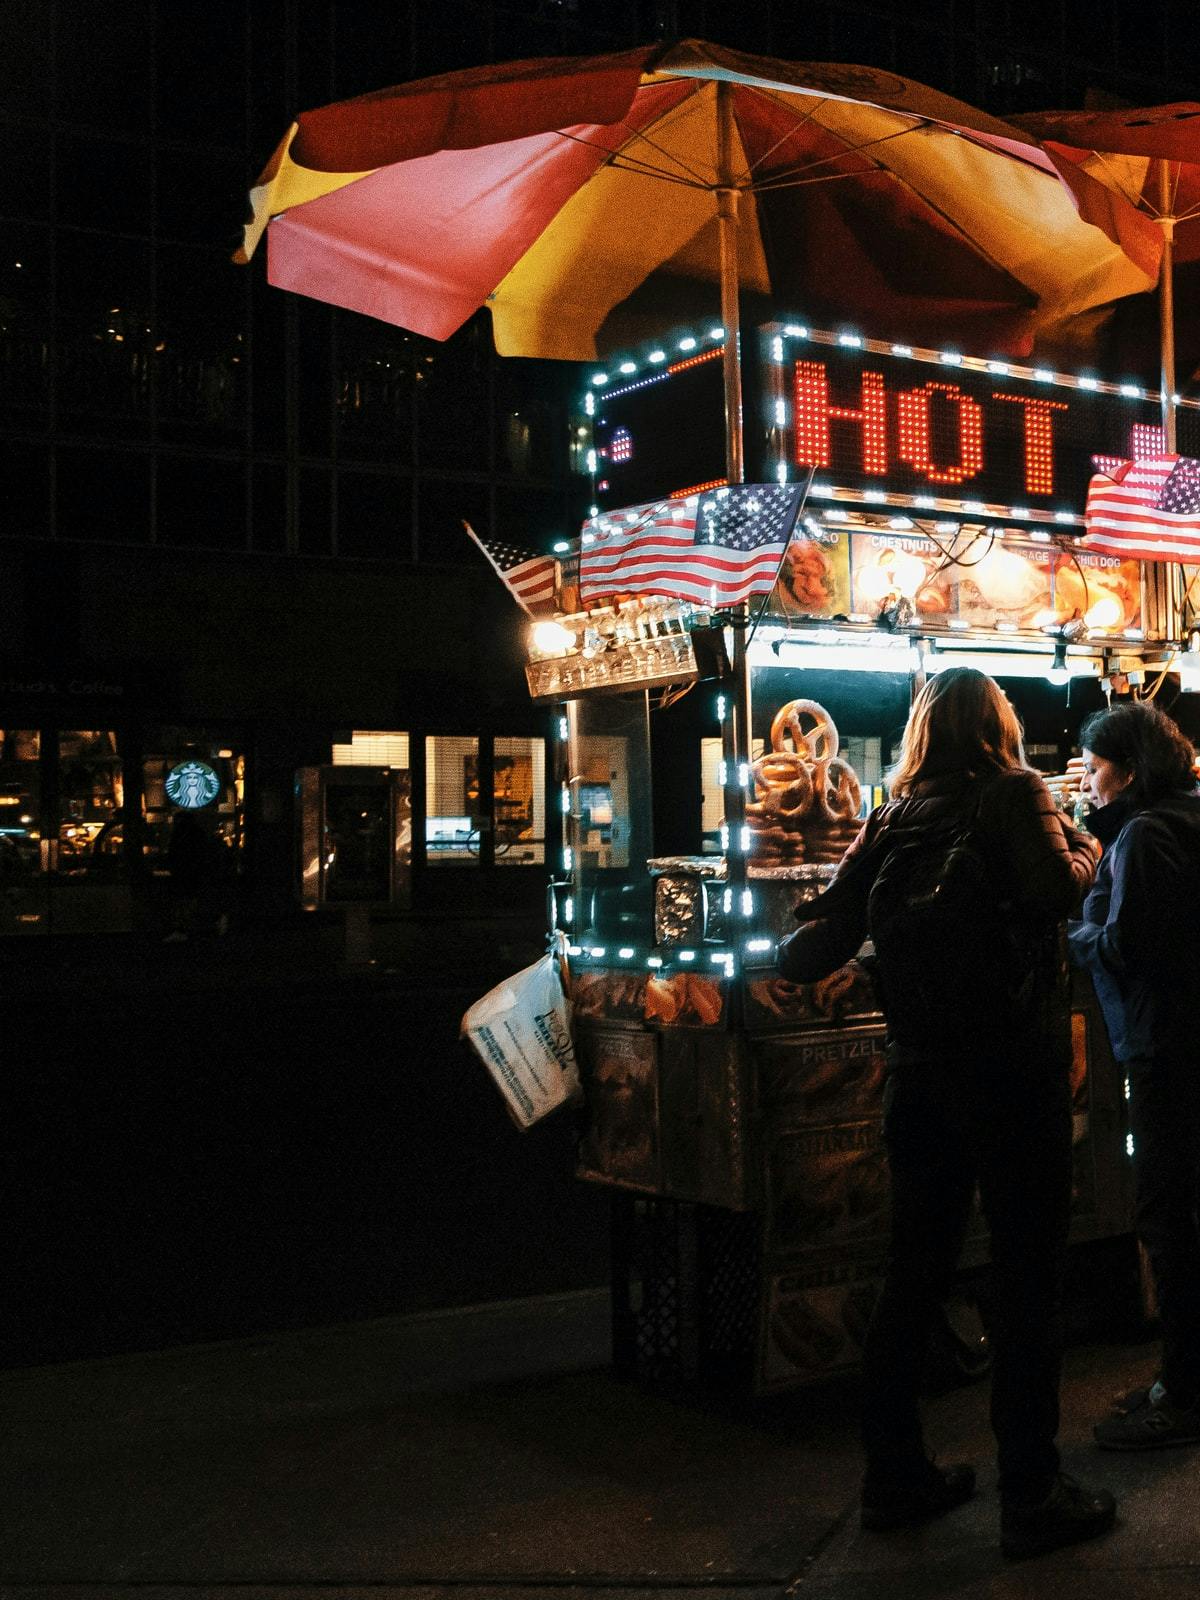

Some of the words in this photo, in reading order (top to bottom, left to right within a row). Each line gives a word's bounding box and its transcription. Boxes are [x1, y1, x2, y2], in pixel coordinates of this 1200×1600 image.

[793, 359, 1069, 497] HOT
[871, 535, 938, 554] CHESTNUTS
[1074, 554, 1098, 567] CHILI
[1100, 556, 1121, 568] DOG
[801, 1037, 882, 1064] PRETZEL
